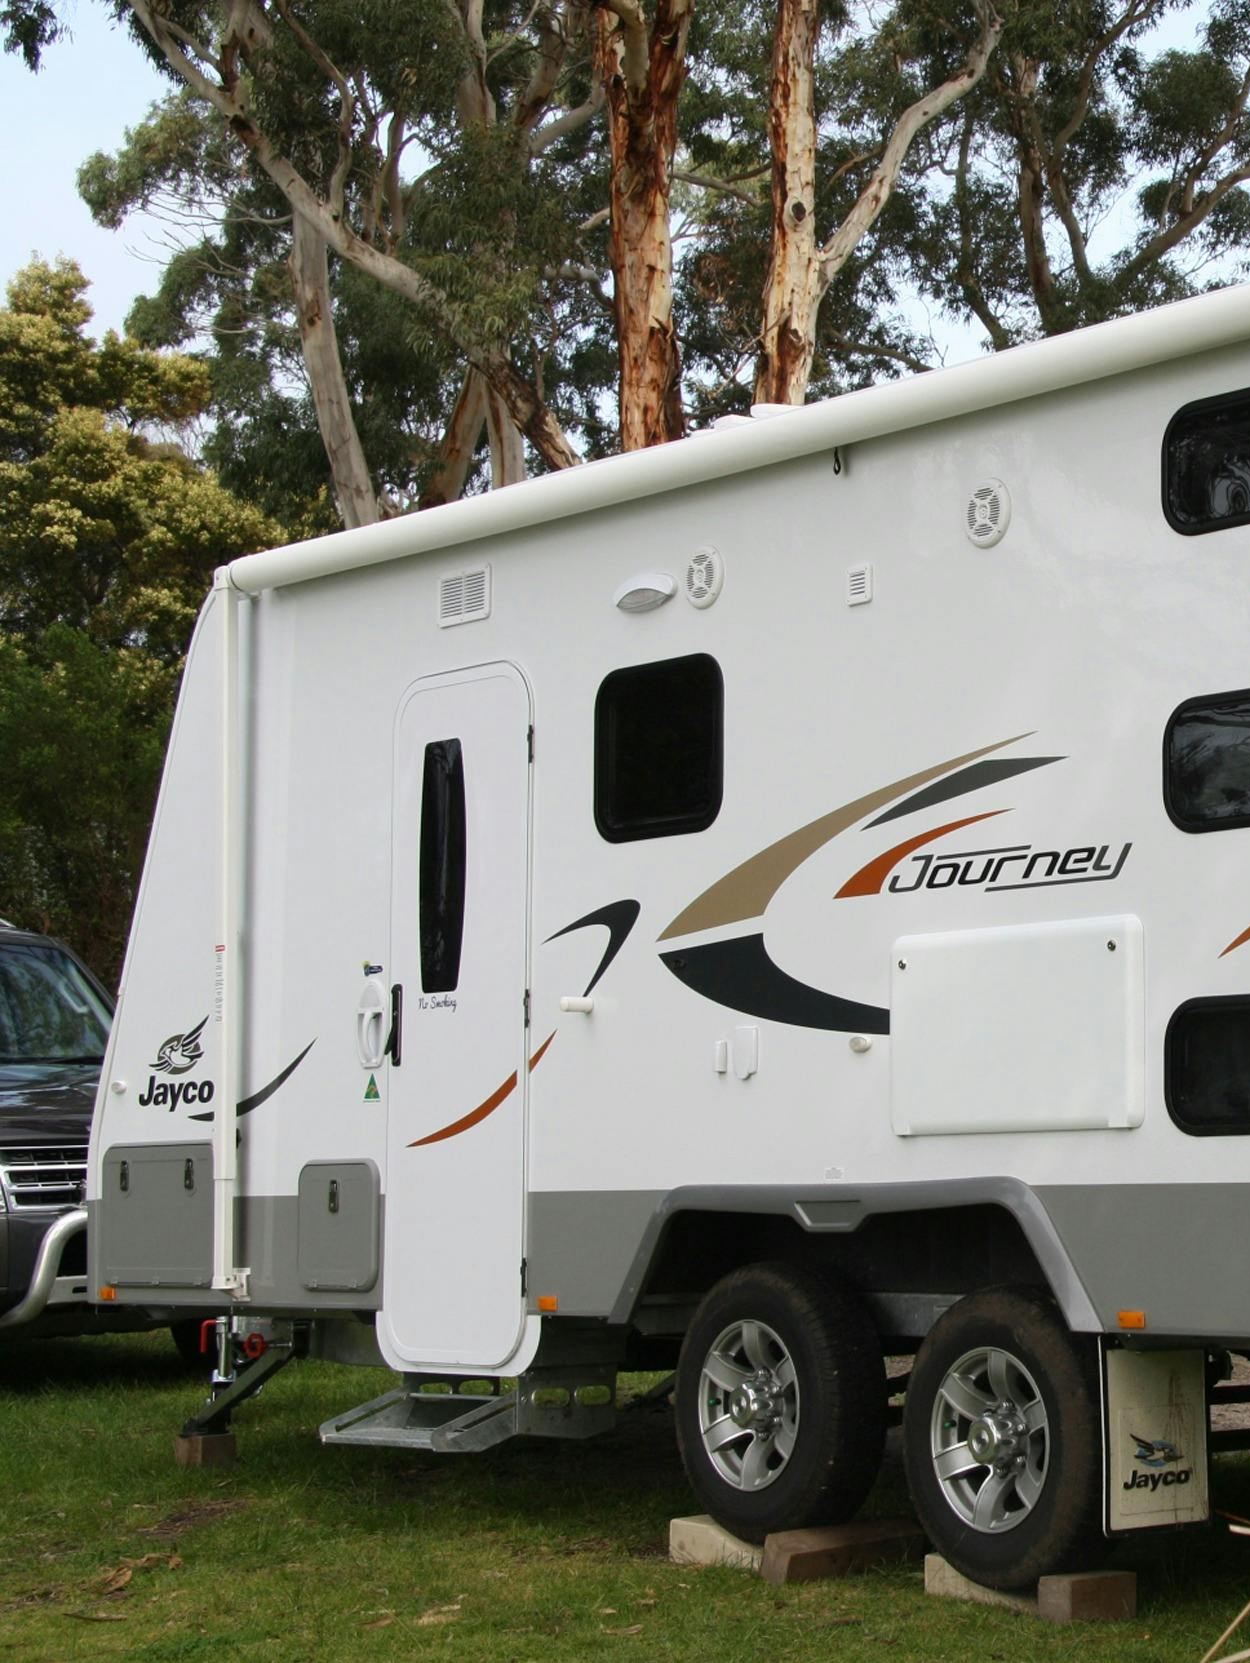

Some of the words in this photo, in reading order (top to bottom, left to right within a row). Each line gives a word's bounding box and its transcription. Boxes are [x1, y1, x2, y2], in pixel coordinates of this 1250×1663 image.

[887, 842, 1133, 893] Journey
[430, 994, 457, 1013] Smoking
[138, 1075, 215, 1112] Jayco
[1123, 1469, 1191, 1492] Jayco
